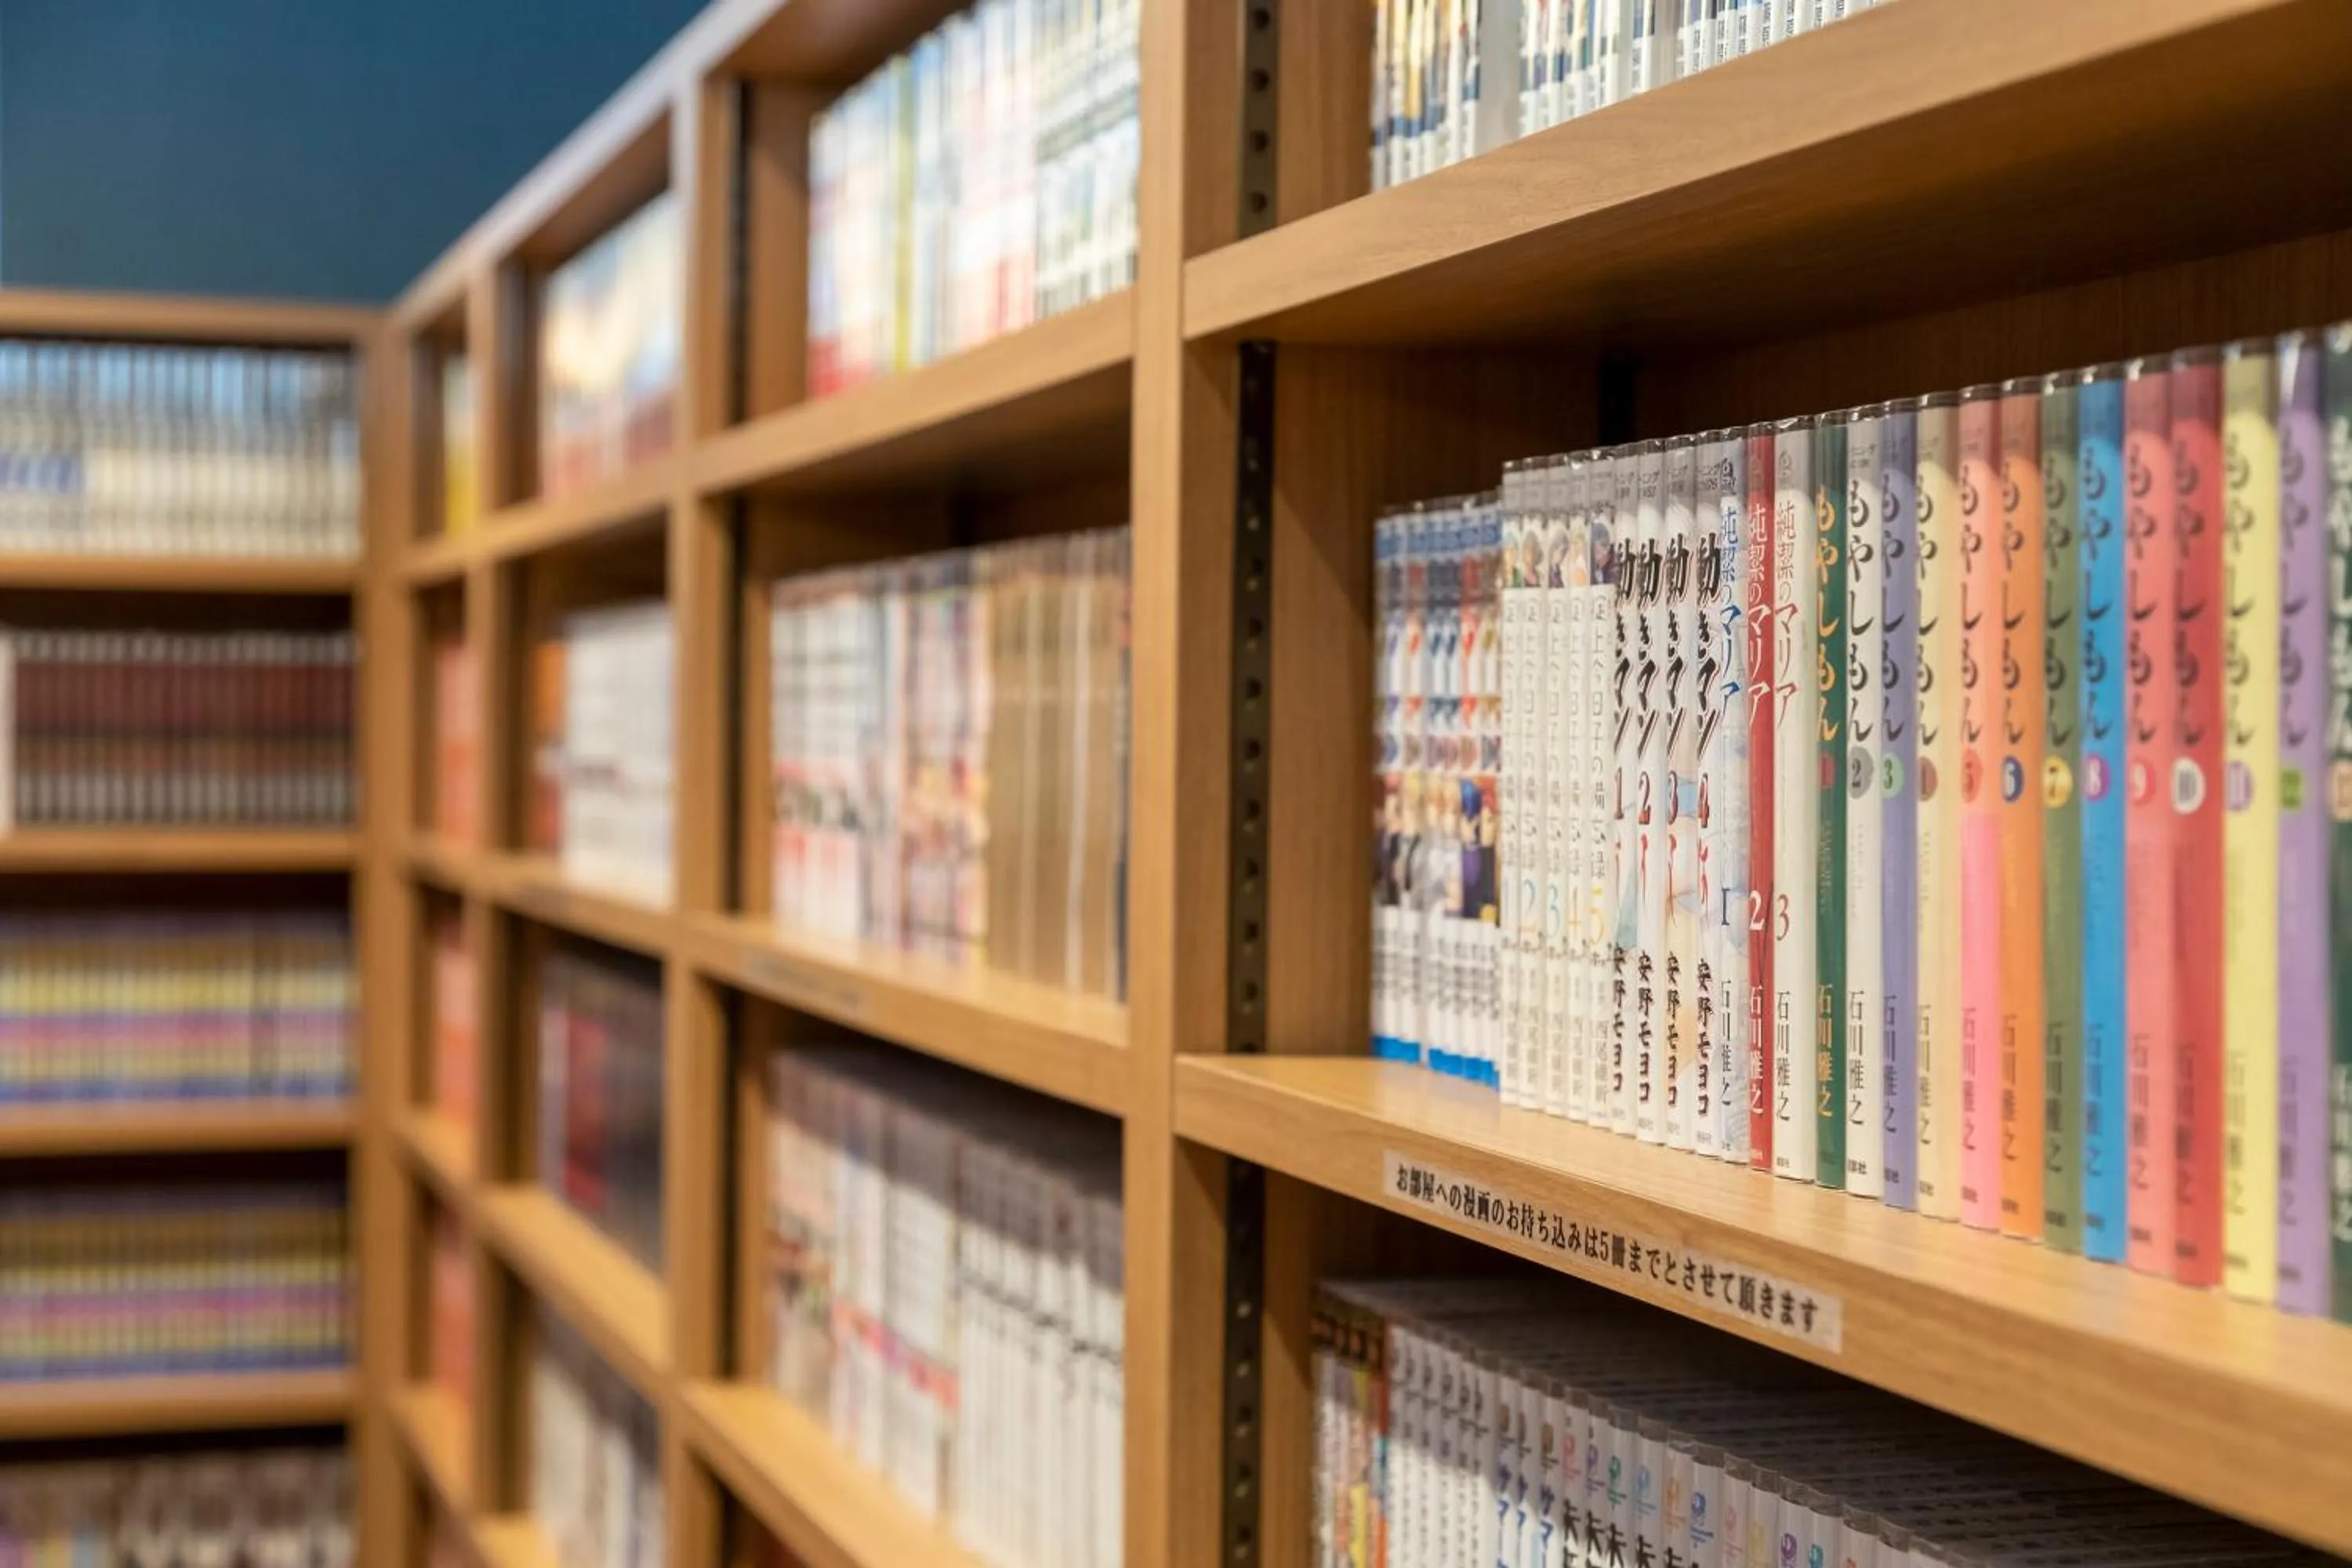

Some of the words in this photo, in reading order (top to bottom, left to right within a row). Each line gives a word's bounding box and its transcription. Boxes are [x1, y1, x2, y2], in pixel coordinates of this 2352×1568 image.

[1775, 499, 1798, 729] 純潔のマリア
[1817, 484, 1839, 741] もやしもん
[1849, 479, 1875, 742] もやしもん
[1882, 474, 1905, 742] もやしもん
[1916, 474, 1939, 746] もやしもん
[1961, 464, 1983, 742] もやしもん
[2002, 461, 2025, 744] もやしもん
[2044, 455, 2072, 746] もやしもん
[2081, 446, 2113, 741] もやしもん
[2129, 442, 2158, 742] もやしもん
[1614, 768, 1624, 820] 1
[1639, 771, 1651, 826] 2
[1668, 770, 1679, 826] 3
[1852, 758, 1862, 788] 2
[1884, 758, 1893, 789] 3
[1749, 889, 1766, 931] 2
[1777, 893, 1790, 942] 3
[1639, 951, 1652, 1103] 安野モヨコ
[1668, 950, 1679, 1105] 安野モヨコ
[1697, 958, 1712, 1116] 安野モヨコ
[1749, 985, 1764, 1114] 石川雅之
[1777, 990, 1791, 1121] 石川雅之
[1818, 985, 1833, 1116] 石川雅之
[1849, 991, 1864, 1124] 石川雅之
[1883, 995, 1896, 1132] 石川雅之
[1396, 1162, 1819, 1333] お部屋への漫画のお持ち込みは5冊までとさせて頂きます
